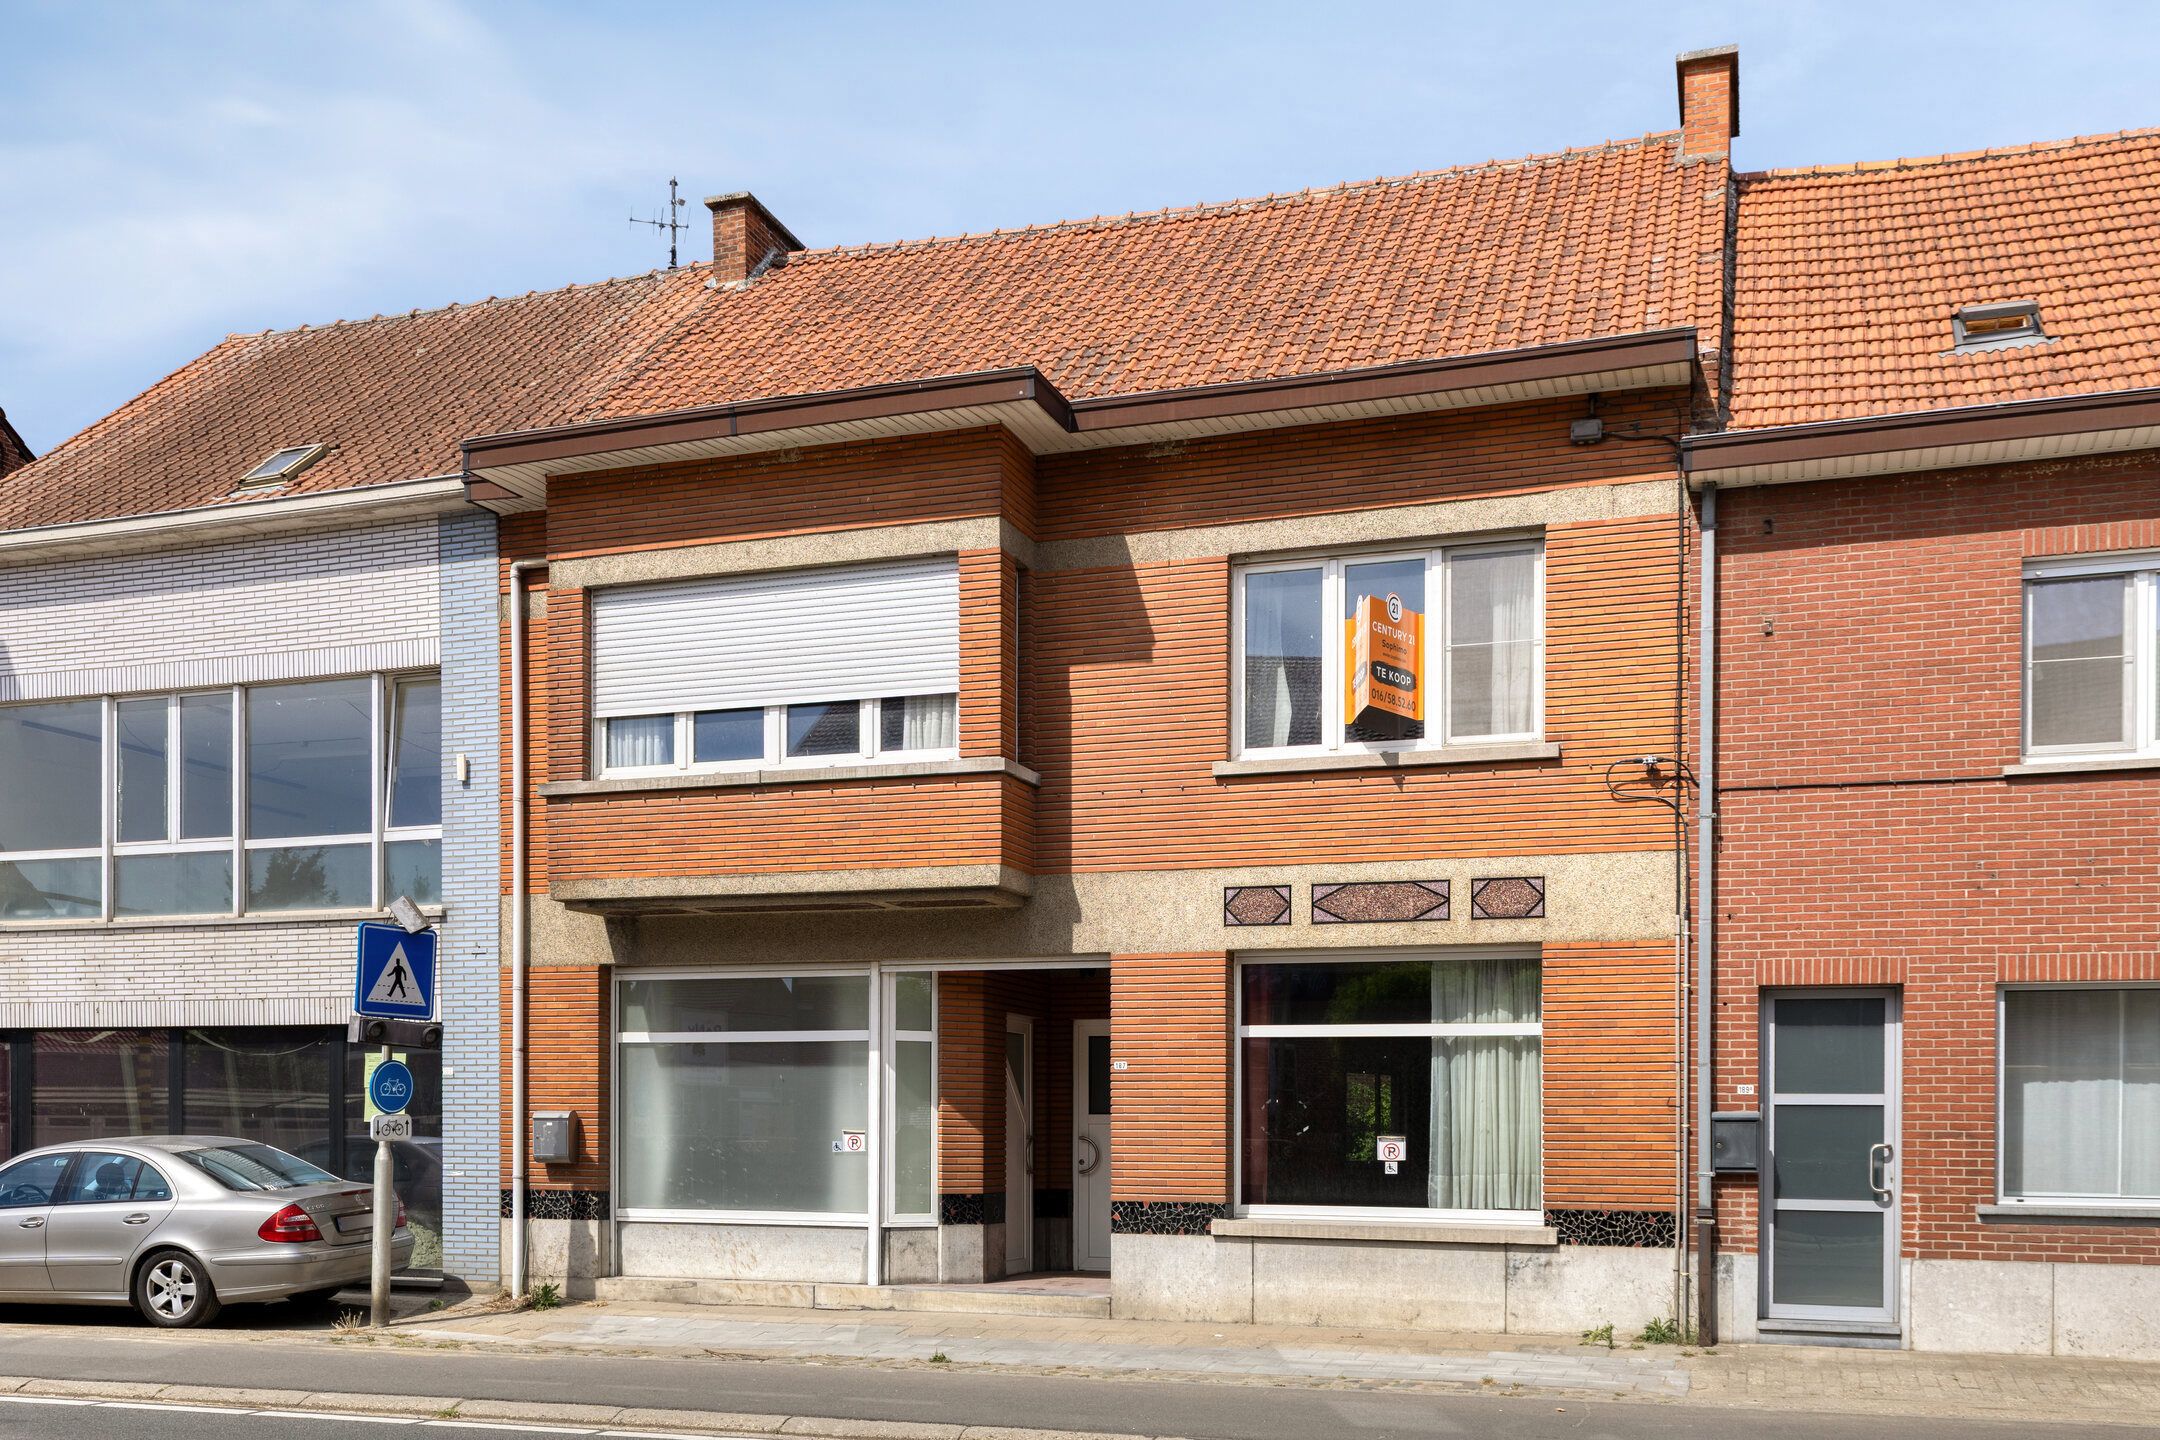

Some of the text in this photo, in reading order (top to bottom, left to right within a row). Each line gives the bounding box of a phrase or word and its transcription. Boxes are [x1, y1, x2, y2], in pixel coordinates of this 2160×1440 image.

[1372, 621, 1408, 642] CENTURY
[1408, 634, 1415, 646] 21
[1382, 639, 1407, 655] Sophimo
[1376, 666, 1387, 679] TE
[1389, 670, 1412, 686] KOOP
[1371, 688, 1416, 712] 016/58.52.60
